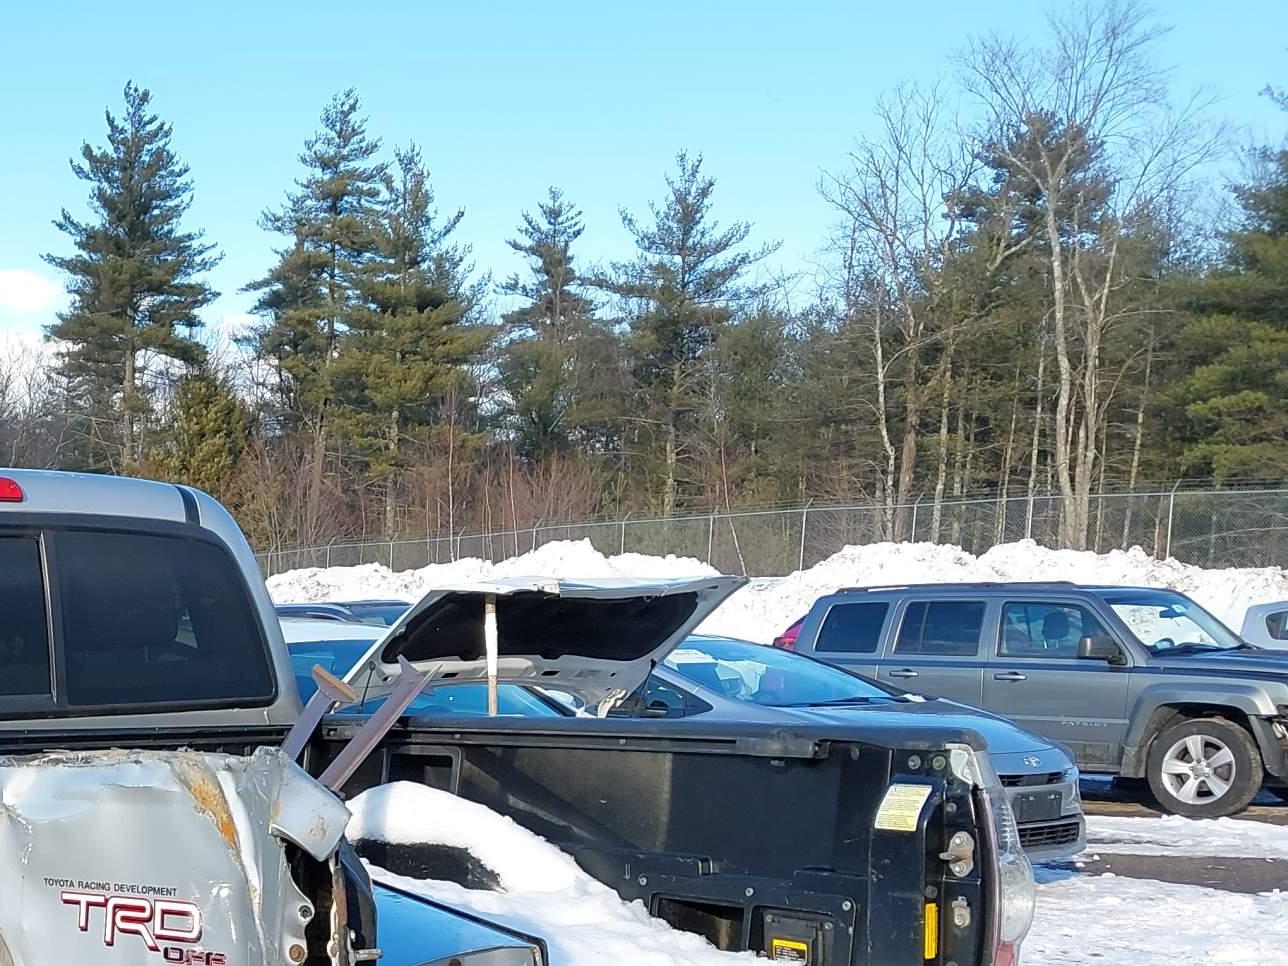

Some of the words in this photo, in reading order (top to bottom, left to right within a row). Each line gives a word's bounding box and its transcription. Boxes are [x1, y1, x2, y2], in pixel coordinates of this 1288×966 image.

[43, 877, 75, 889] TOYOTA
[77, 881, 111, 892] RACING
[113, 883, 178, 897] DEVELOPMENT
[60, 891, 203, 953] TRD
